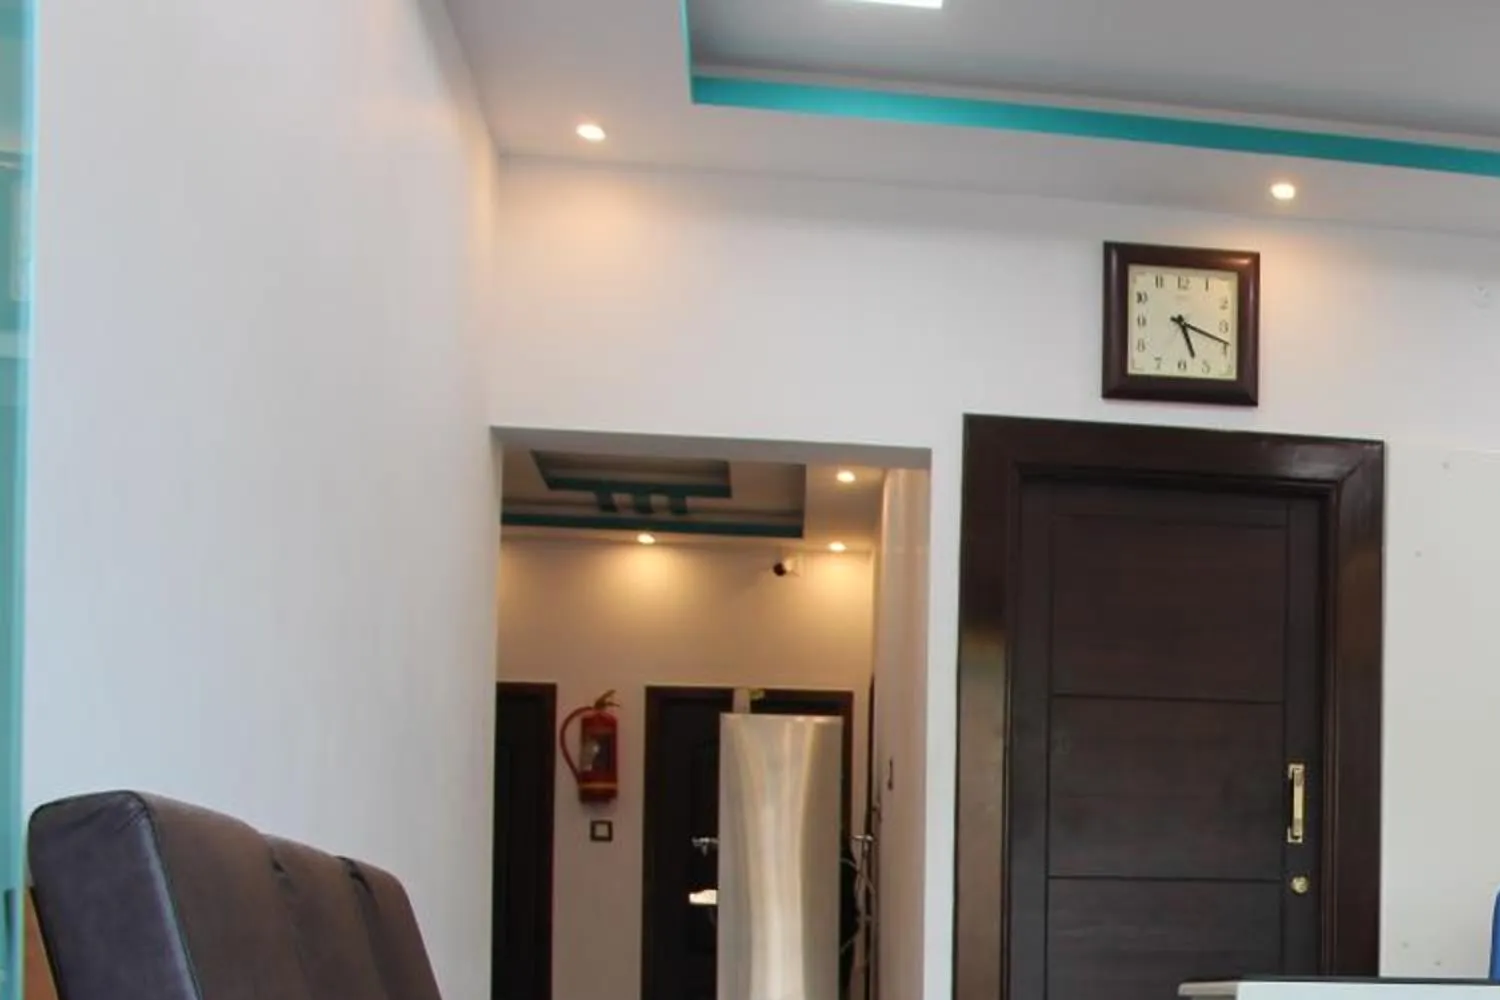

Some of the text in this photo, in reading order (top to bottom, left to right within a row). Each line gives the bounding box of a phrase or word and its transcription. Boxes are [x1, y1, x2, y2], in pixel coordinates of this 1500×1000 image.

[1177, 275, 1190, 290] 12
[1136, 291, 1148, 304] 10
[1219, 297, 1228, 310] 2
[1219, 320, 1229, 334] 3
[1154, 357, 1162, 370] 7
